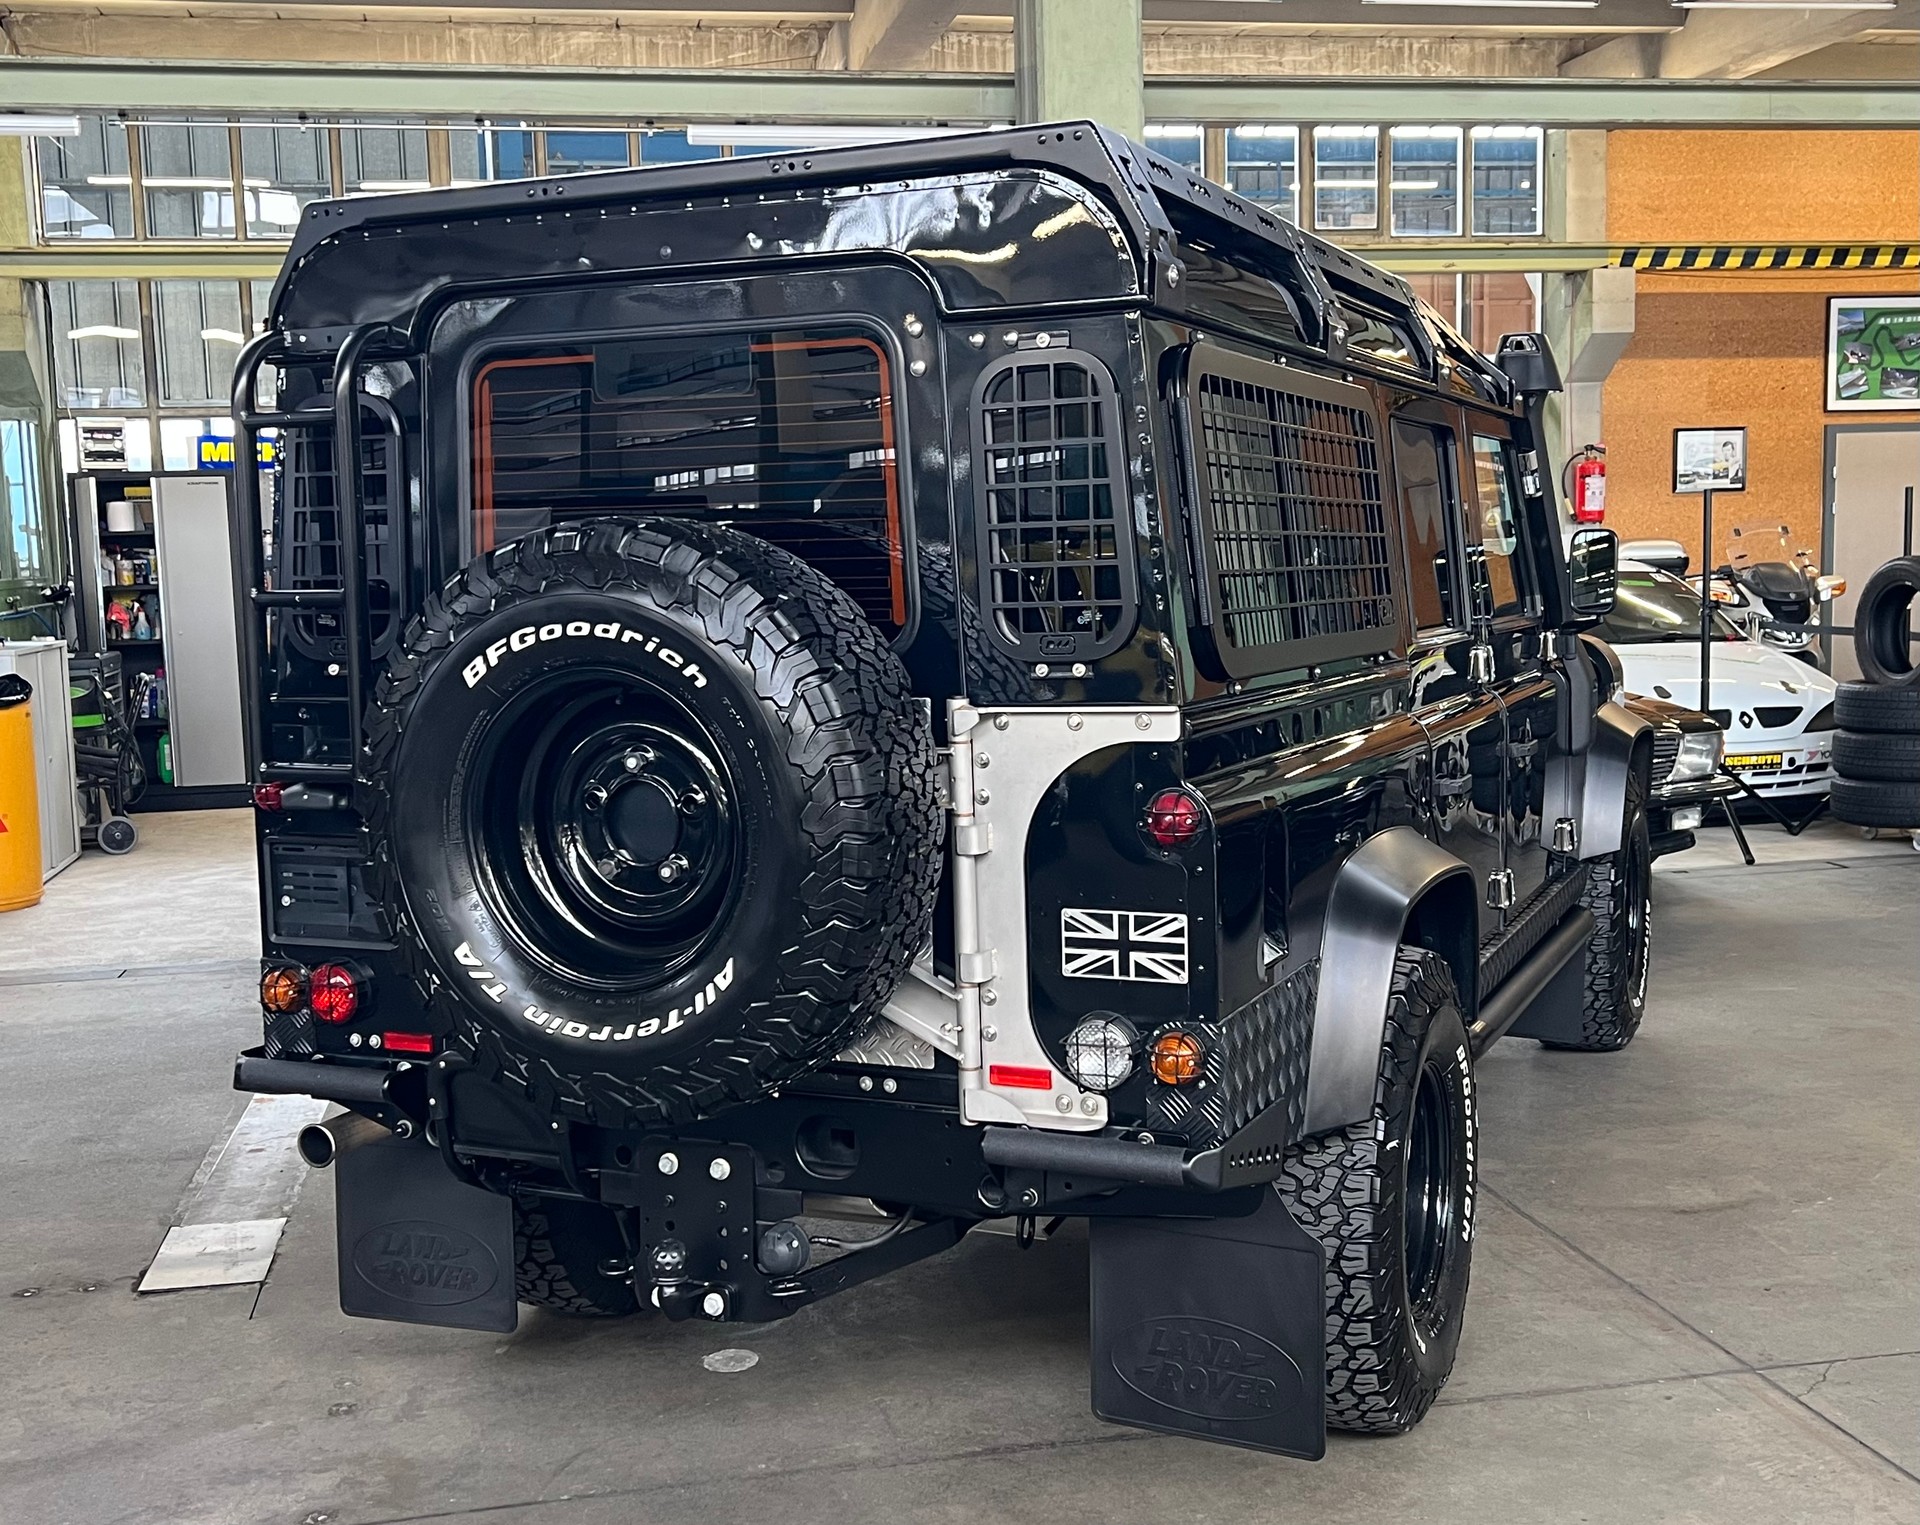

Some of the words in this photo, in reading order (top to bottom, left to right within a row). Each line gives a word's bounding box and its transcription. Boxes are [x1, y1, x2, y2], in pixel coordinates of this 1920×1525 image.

[462, 621, 708, 689] BFGoodrich
[453, 941, 508, 1003] T/A
[524, 957, 734, 1041] All-Terrain
[1456, 1044, 1474, 1242] BFGoodrich
[390, 1260, 480, 1292] ROVER
[1148, 1327, 1243, 1367] LAND
[1157, 1361, 1278, 1408] ROVER
